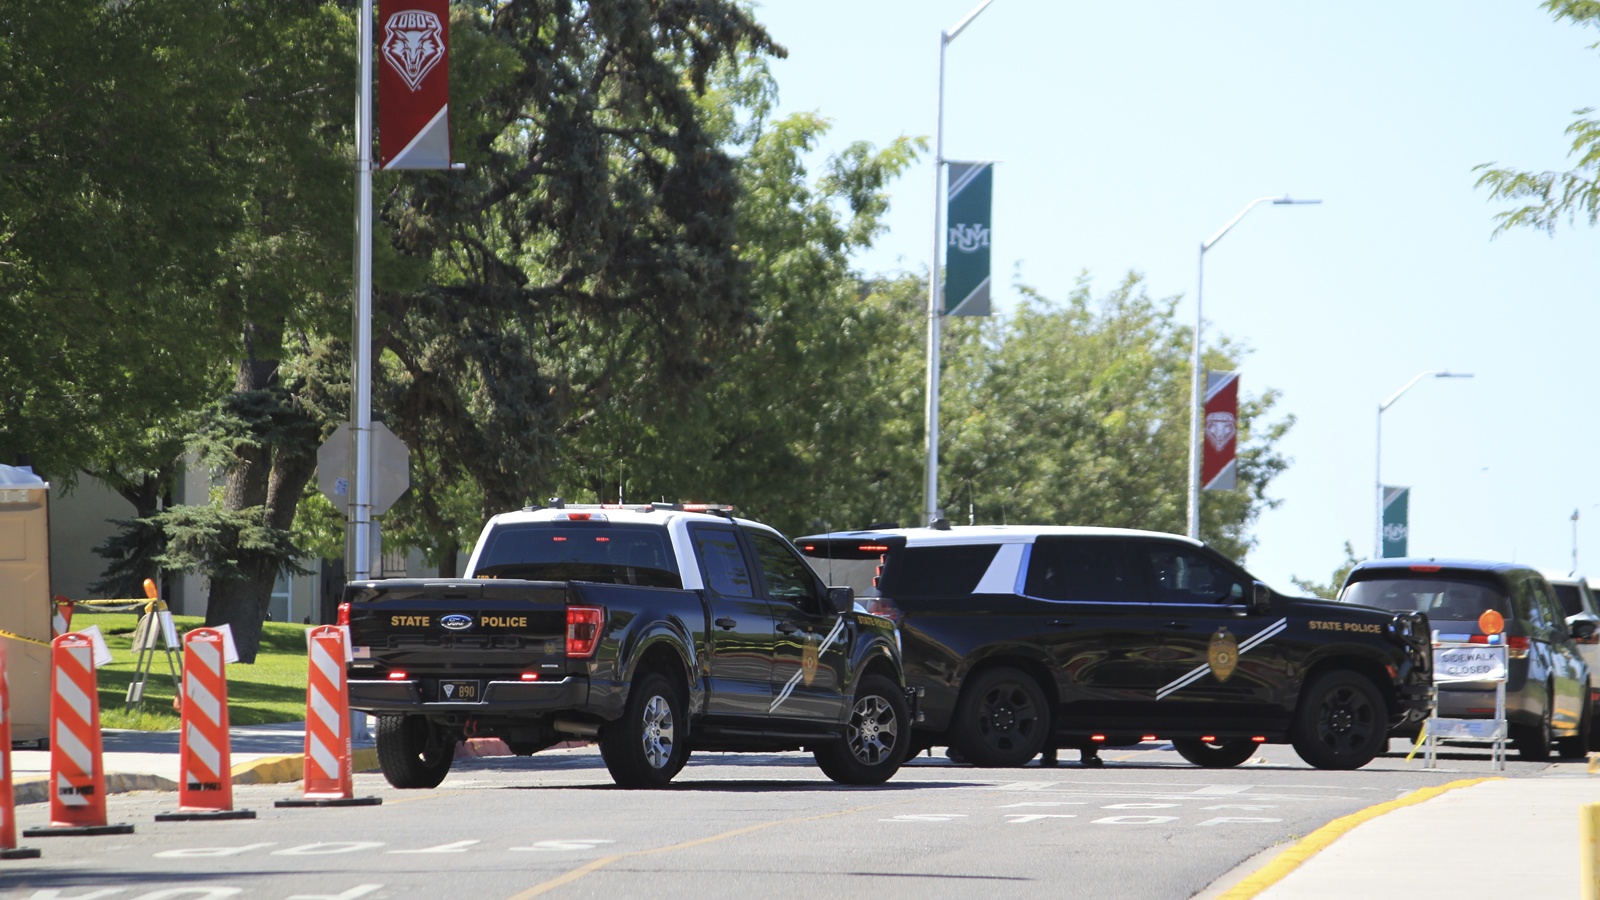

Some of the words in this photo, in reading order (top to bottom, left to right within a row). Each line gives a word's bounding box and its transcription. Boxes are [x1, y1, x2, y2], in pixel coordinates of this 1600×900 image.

[390, 13, 437, 29] LOBOS
[391, 615, 430, 627] STATE
[481, 616, 527, 628] POLICE
[1308, 620, 1342, 631] STATE
[1343, 622, 1382, 634] POLICE
[1441, 653, 1496, 663] SIDEWALK
[1448, 666, 1491, 675] CLOSED
[458, 686, 475, 698] 890
[998, 801, 1280, 811] FOR
[877, 813, 1286, 826] STOP
[152, 838, 616, 858] STOP
